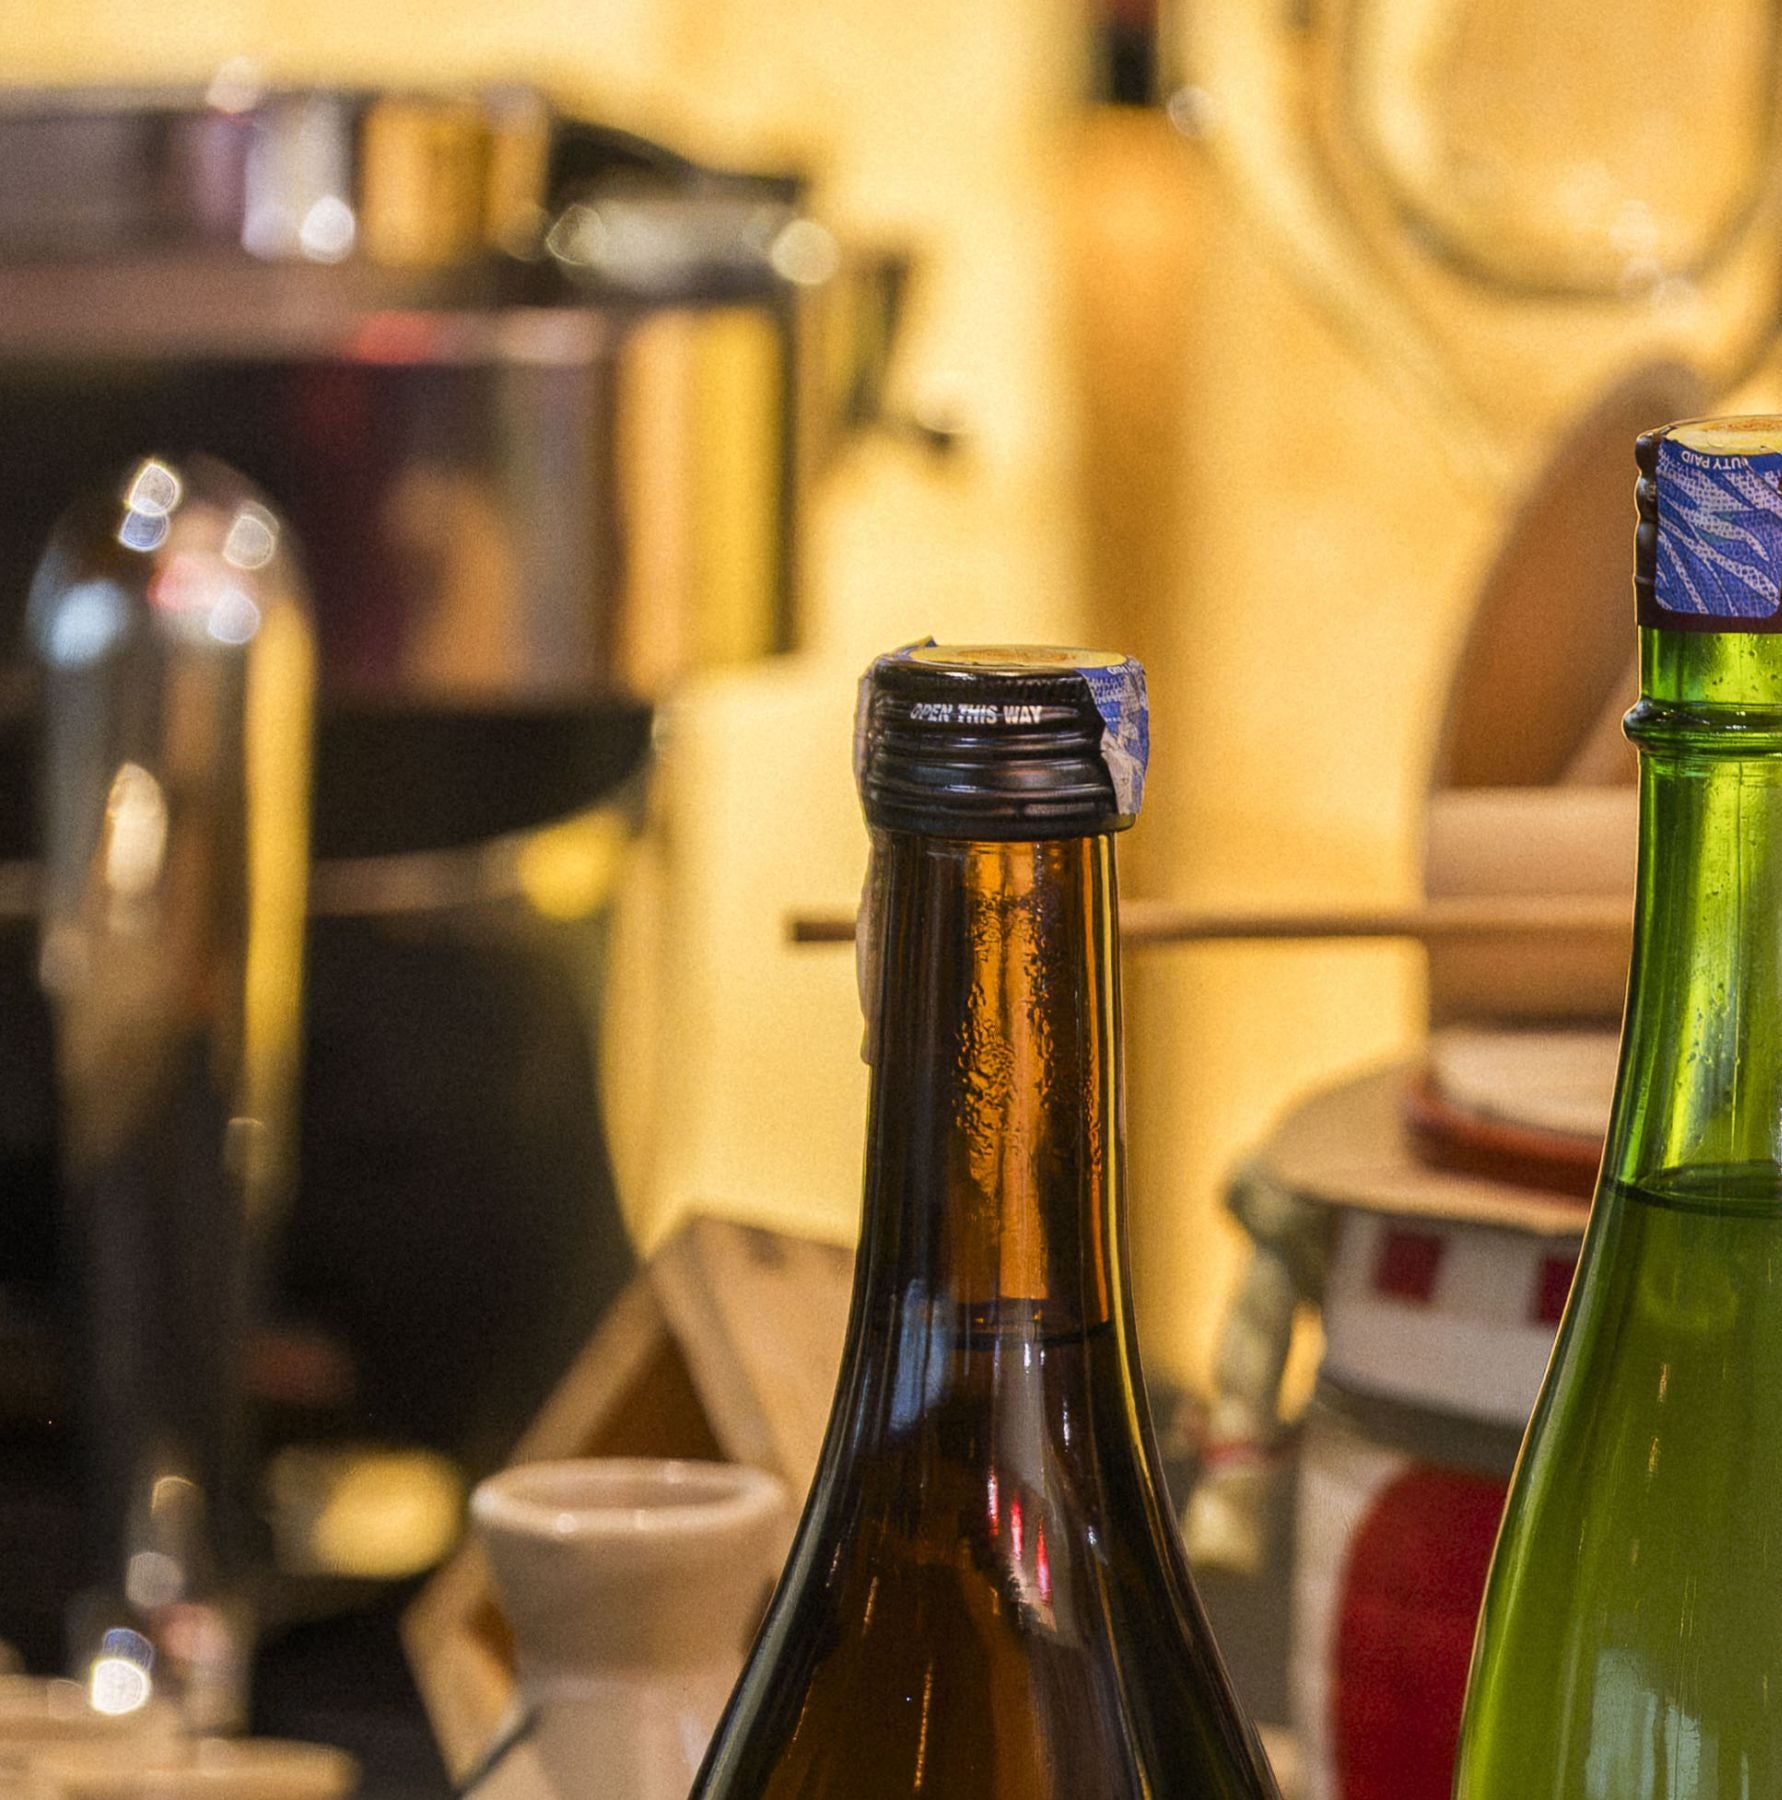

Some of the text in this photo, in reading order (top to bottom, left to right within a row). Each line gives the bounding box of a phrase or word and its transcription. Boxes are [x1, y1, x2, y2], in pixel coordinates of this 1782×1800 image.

[910, 702, 1043, 725] OPEN THIS WAY
